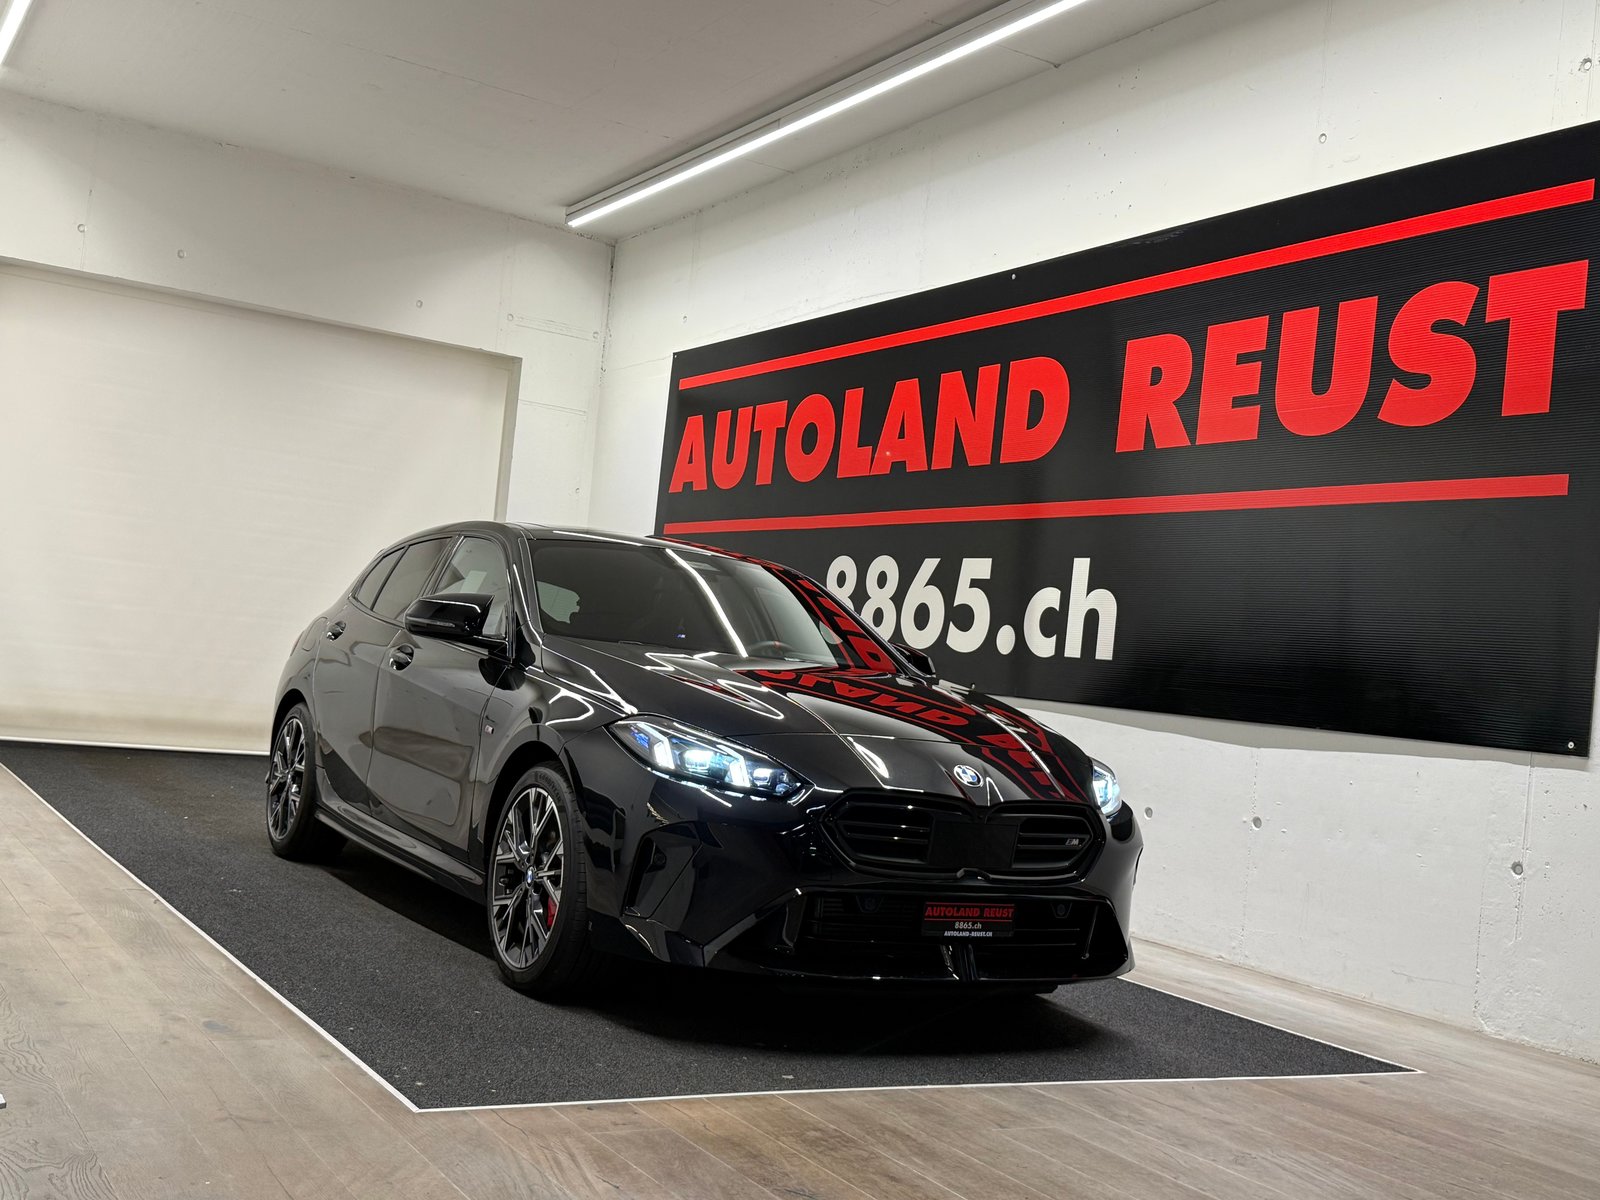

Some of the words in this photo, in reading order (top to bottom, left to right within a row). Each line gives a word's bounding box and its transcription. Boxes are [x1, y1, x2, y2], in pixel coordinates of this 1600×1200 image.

[669, 355, 1071, 494] AUTOLAND
[1115, 260, 1589, 453] REUST
[925, 906, 980, 917] AUTOLAND
[984, 908, 1014, 918] REUST
